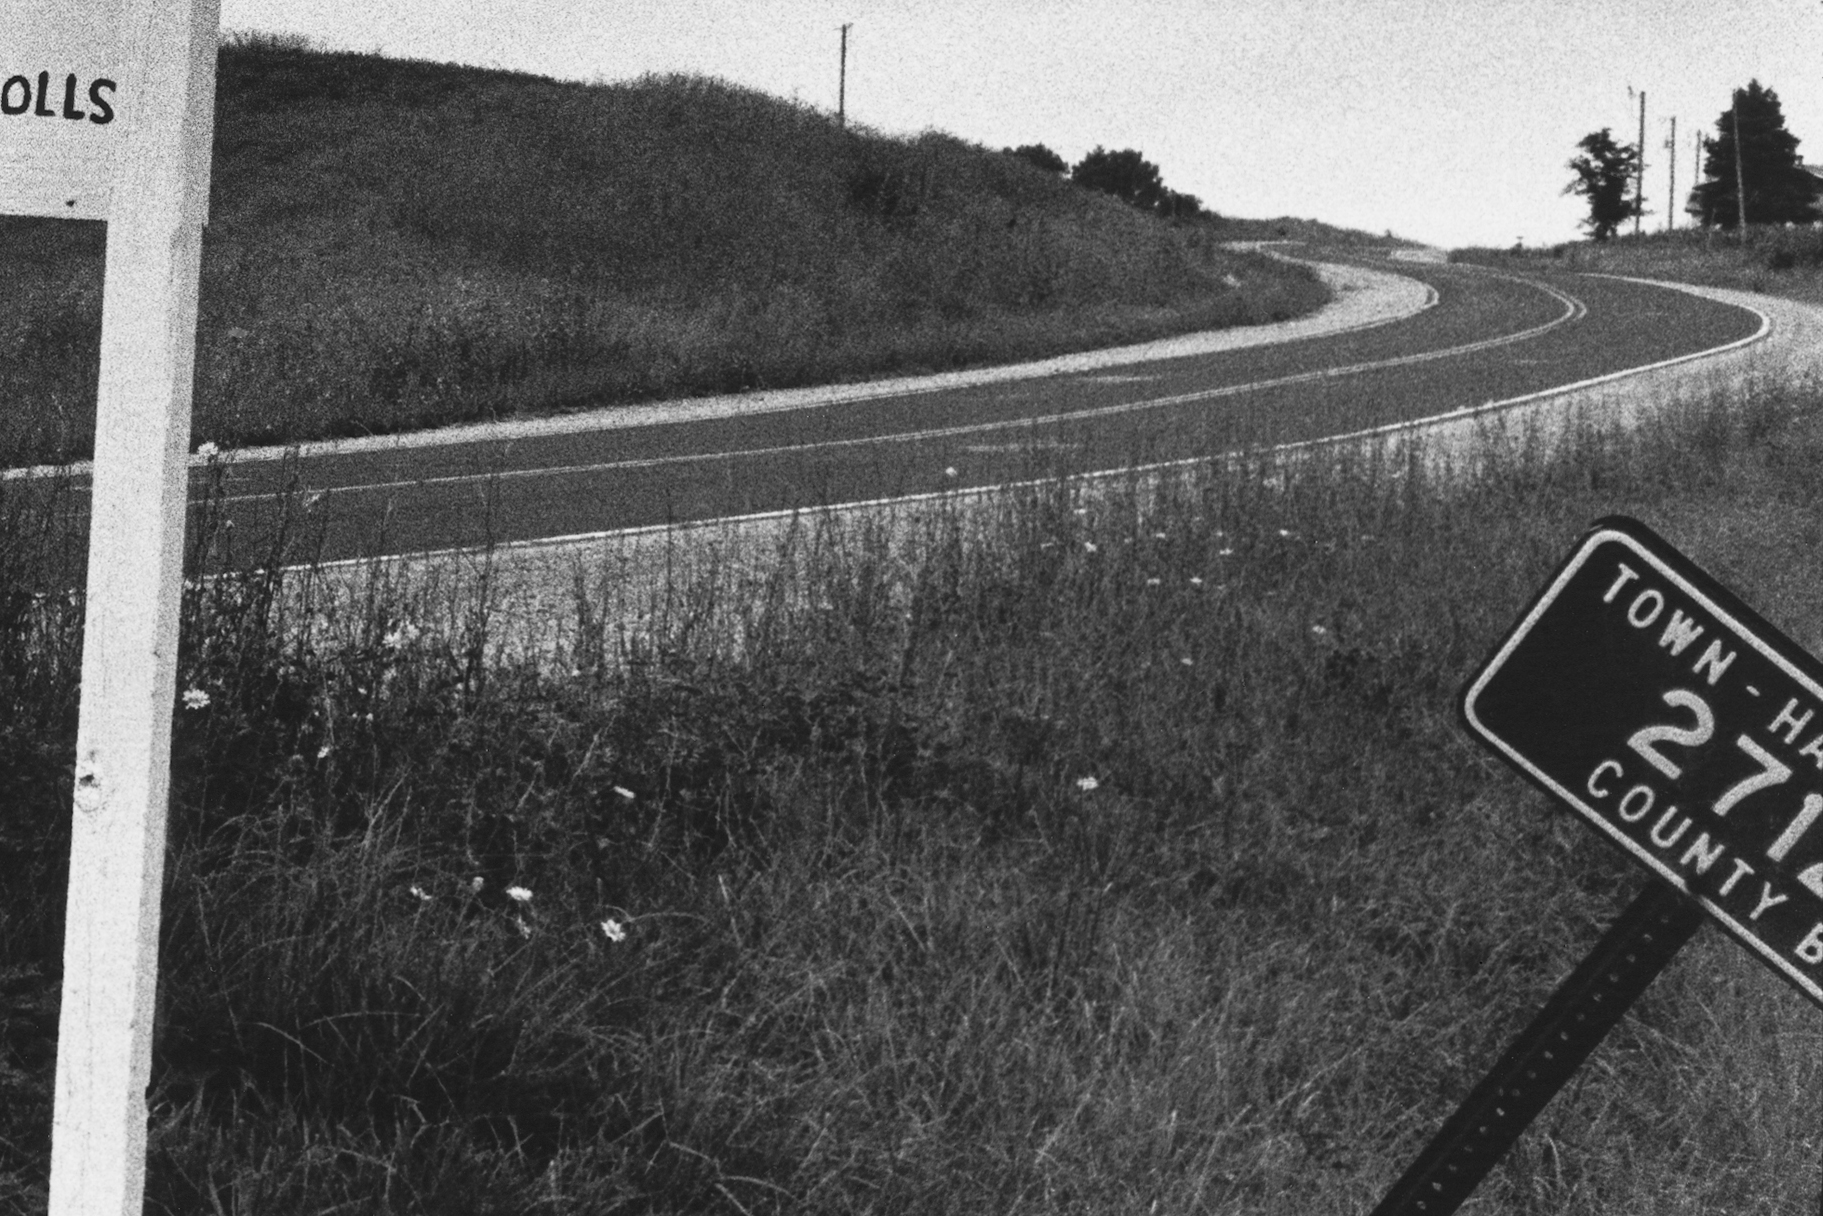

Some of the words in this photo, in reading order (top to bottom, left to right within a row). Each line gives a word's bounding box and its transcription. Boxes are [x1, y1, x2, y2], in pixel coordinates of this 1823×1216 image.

[1603, 563, 1737, 685] TOWN
[1587, 759, 1789, 920] COUNTY
[1627, 689, 1823, 898] 271
